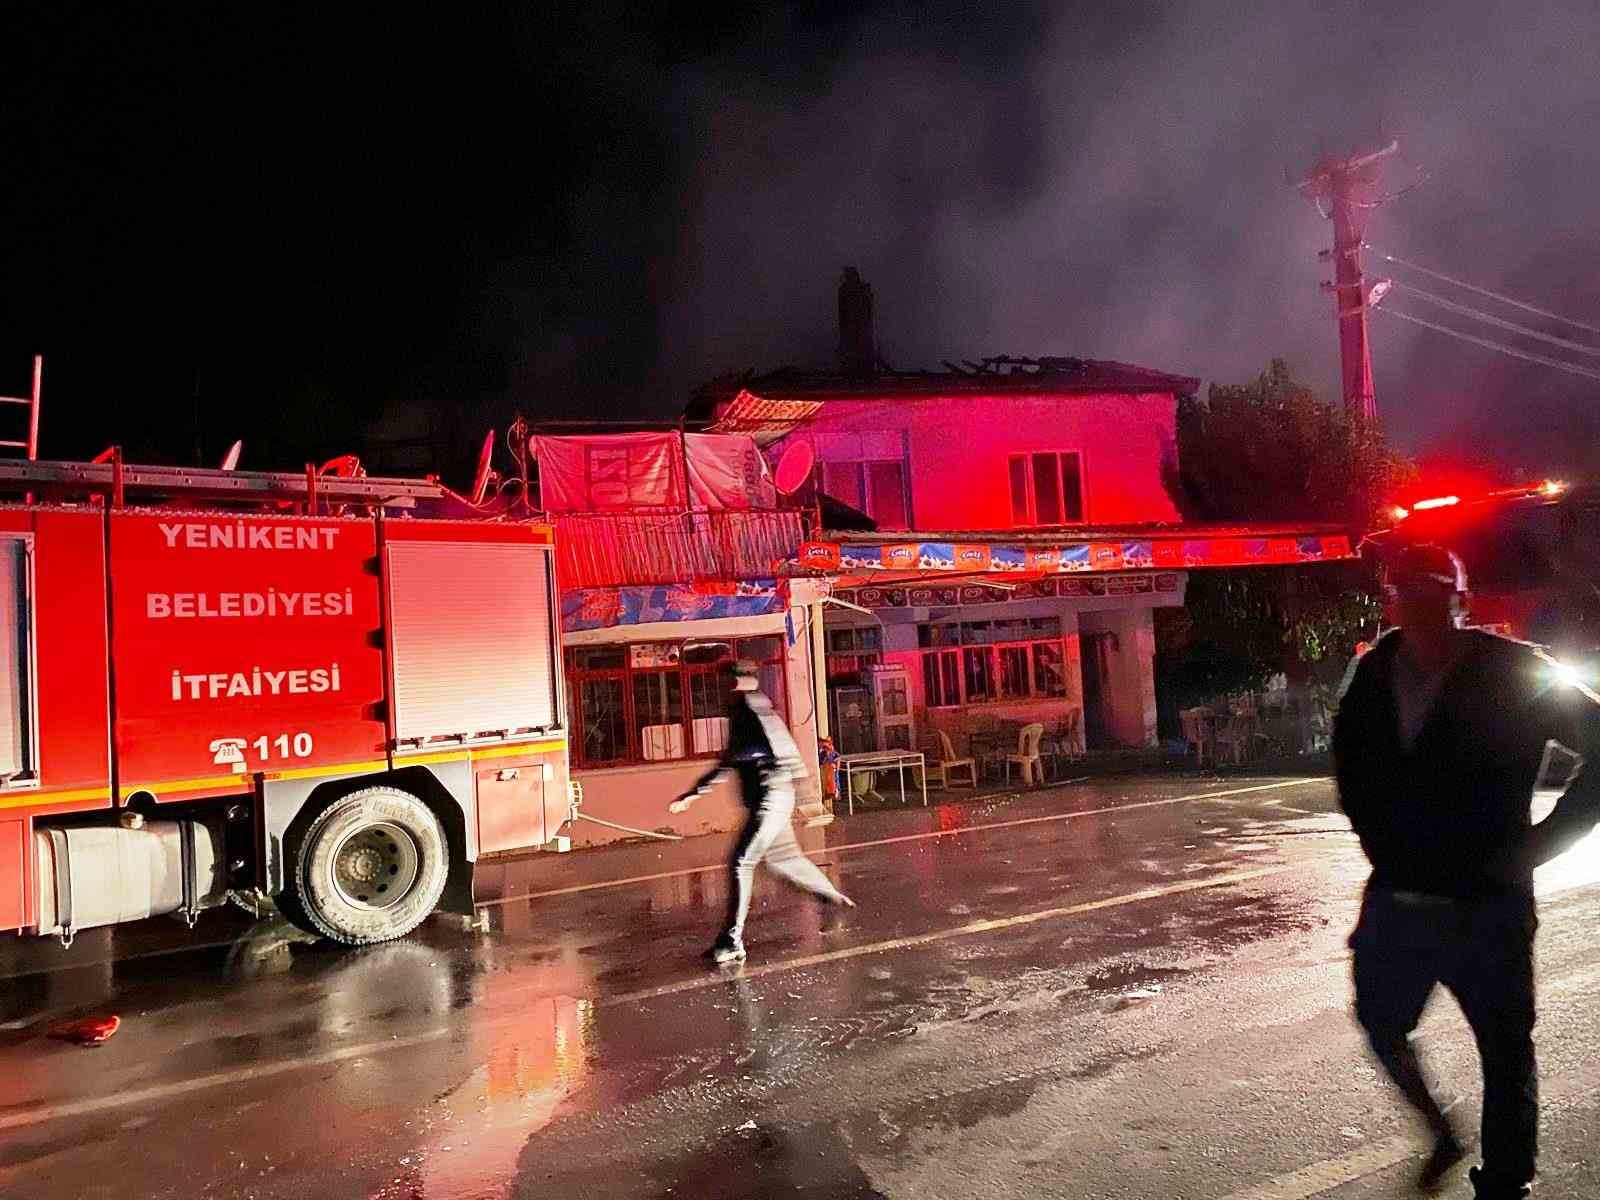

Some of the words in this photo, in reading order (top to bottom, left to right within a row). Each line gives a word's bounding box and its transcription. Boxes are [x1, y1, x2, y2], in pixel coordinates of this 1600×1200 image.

[158, 520, 340, 550] YENİKENT
[146, 587, 353, 618] BELEDİYESİ
[171, 663, 341, 701] İTFAİYESİ
[253, 732, 313, 761] 110
